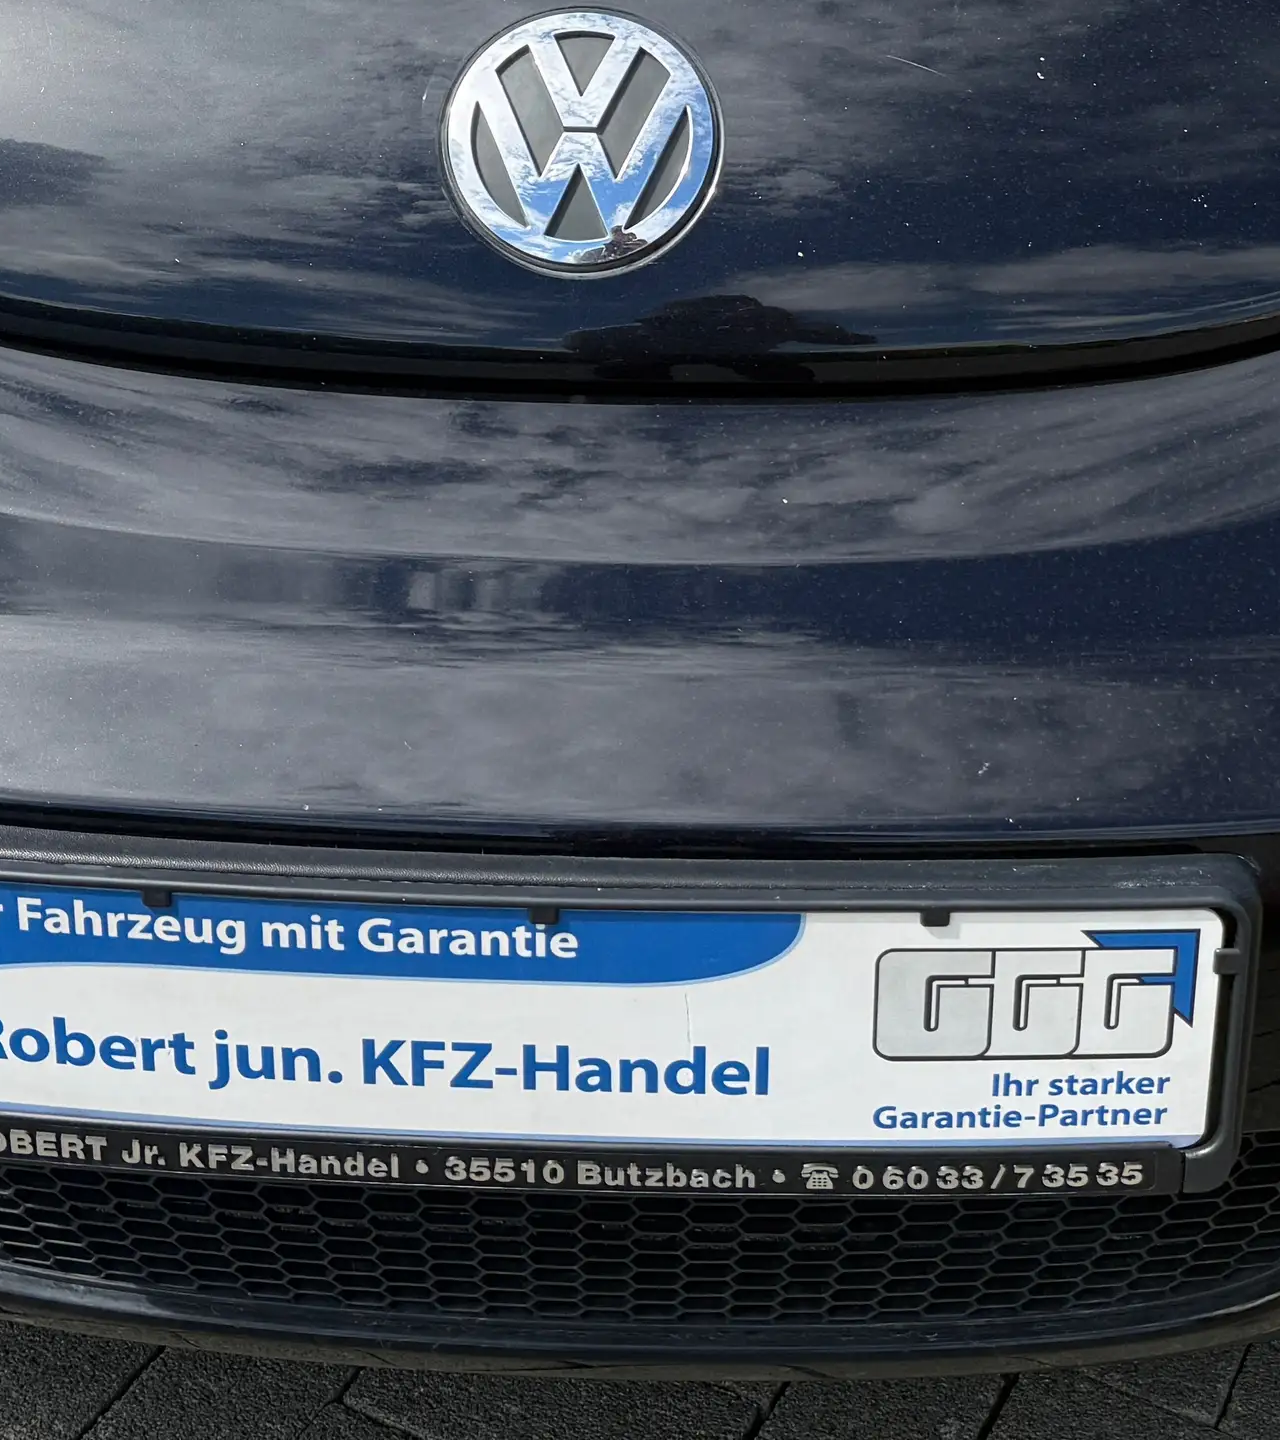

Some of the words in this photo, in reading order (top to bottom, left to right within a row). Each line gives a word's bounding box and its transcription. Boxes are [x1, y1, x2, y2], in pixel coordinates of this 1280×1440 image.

[17, 896, 247, 955] Fahrzeug
[261, 913, 345, 952] mit
[357, 917, 579, 958] Garantie
[208, 1028, 344, 1091] jun.
[362, 1037, 771, 1097] KFZ-Handel
[991, 1072, 1038, 1097] Ihr
[1048, 1070, 1171, 1097] starker
[872, 1103, 1169, 1130] Garantie-Partner
[122, 1138, 166, 1166] Jr.
[179, 1141, 400, 1180] KFZ-Handel
[443, 1155, 565, 1185] 35510
[577, 1159, 756, 1190] Butzbach
